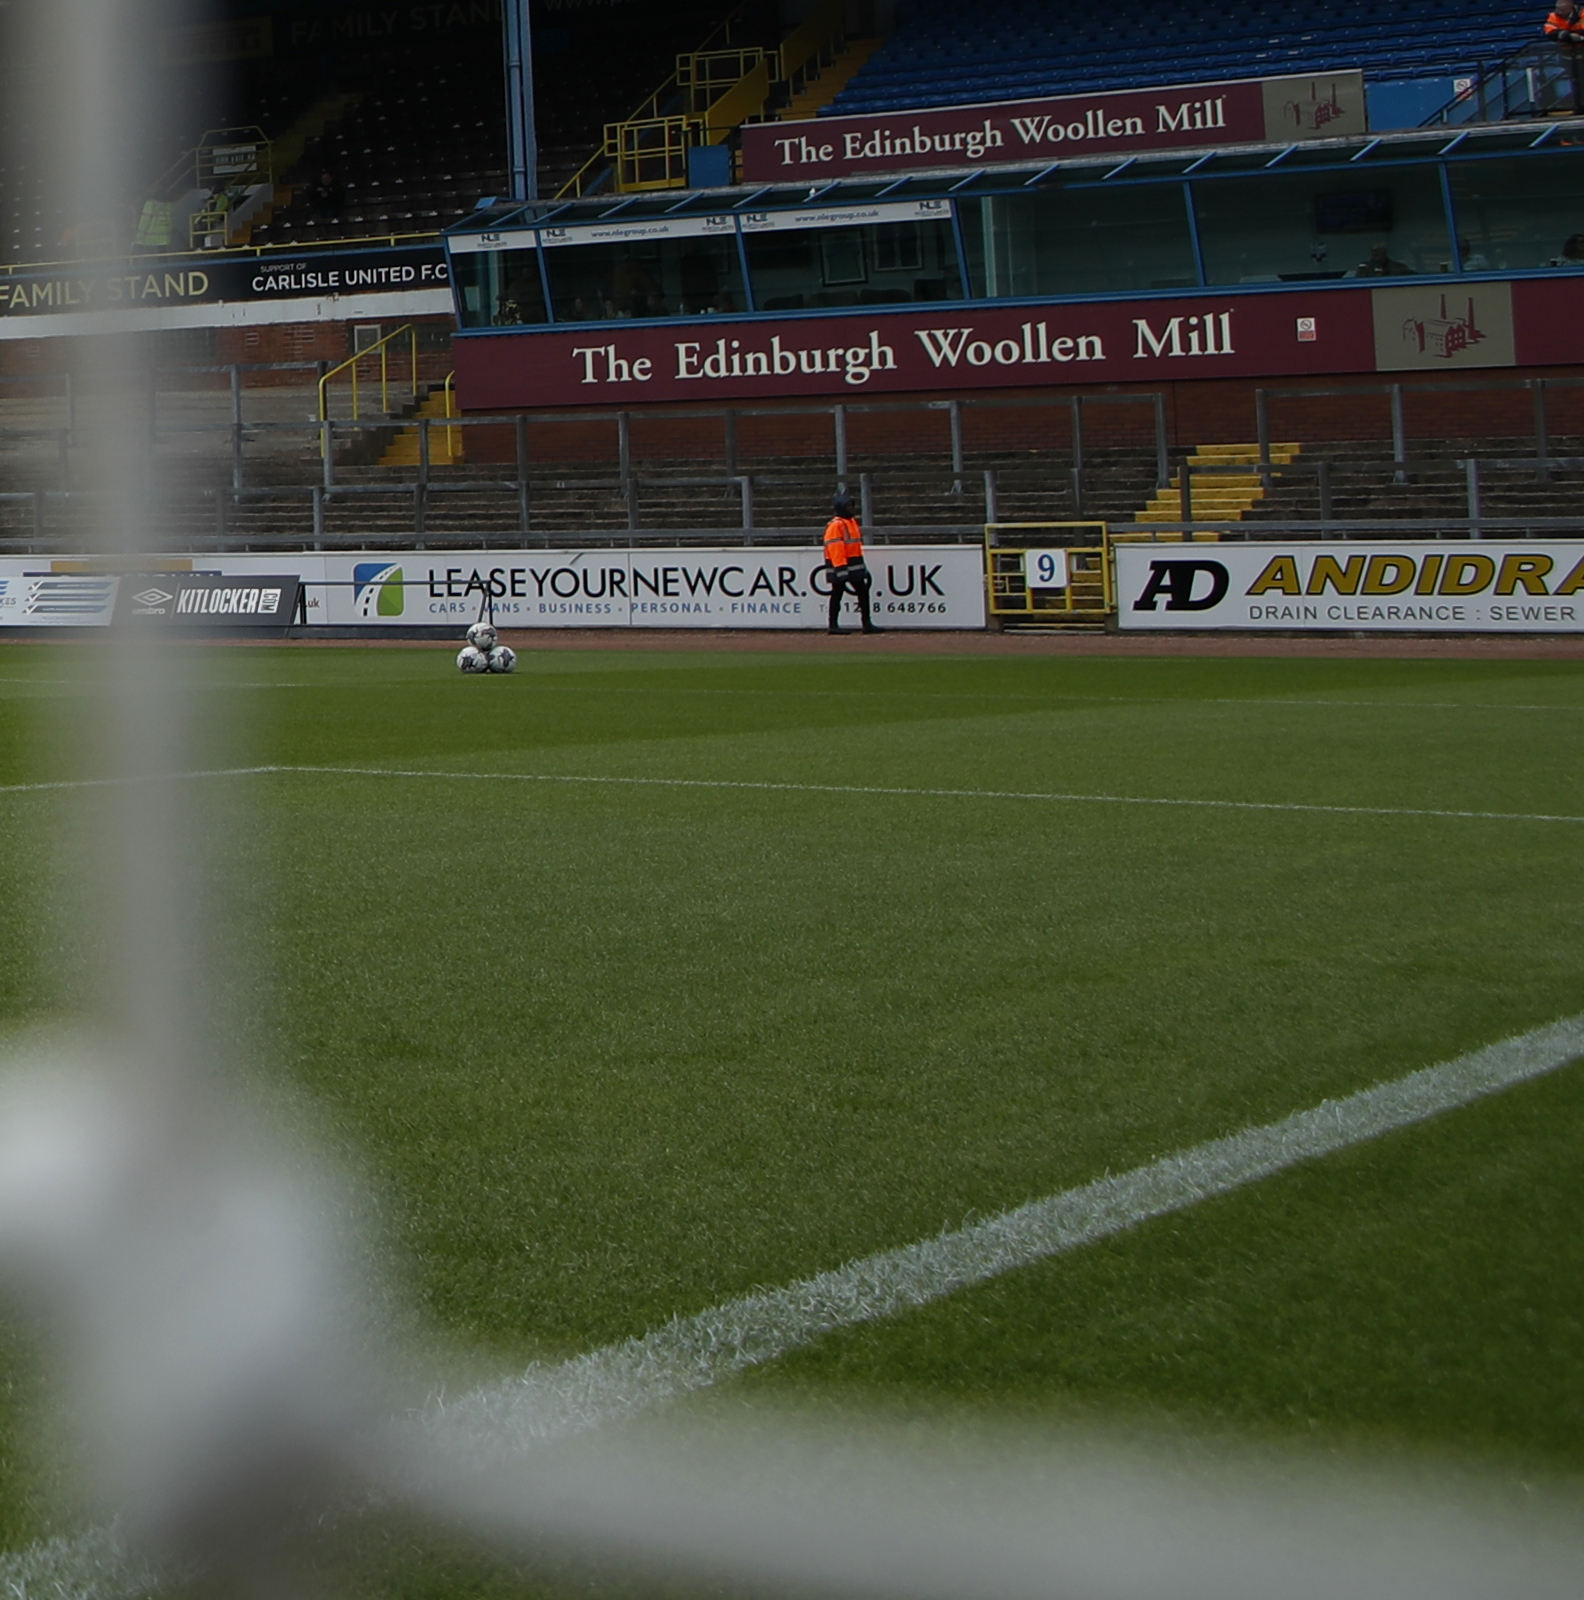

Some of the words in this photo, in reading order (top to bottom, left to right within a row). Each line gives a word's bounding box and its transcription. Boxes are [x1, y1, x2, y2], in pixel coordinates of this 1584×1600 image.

[774, 138, 834, 166] The
[842, 119, 1004, 160] Edinburgh
[1011, 103, 1145, 144] Woollen
[1156, 95, 1227, 132] Mill
[252, 271, 339, 292] CARLISLE
[346, 266, 415, 287] UNITED
[260, 263, 295, 274] SUPPORT
[296, 262, 307, 271] OF
[107, 270, 209, 300] STAND
[573, 345, 653, 385] The
[674, 330, 898, 383] Edinburgh
[914, 321, 1107, 367] Woollen
[1132, 310, 1235, 357] Mill
[1037, 552, 1055, 583] 9
[1133, 560, 1230, 611] AD
[176, 588, 258, 614] KITLOCKER
[429, 603, 466, 614] CARS
[539, 602, 612, 614] BUSINESS
[631, 602, 712, 614] PERSONAL
[732, 602, 802, 614] FINANCE
[887, 602, 947, 613] 648766
[1249, 606, 1317, 621] DRAIN
[1328, 606, 1466, 621] CLEARANCE
[1489, 606, 1576, 621] SEWER
